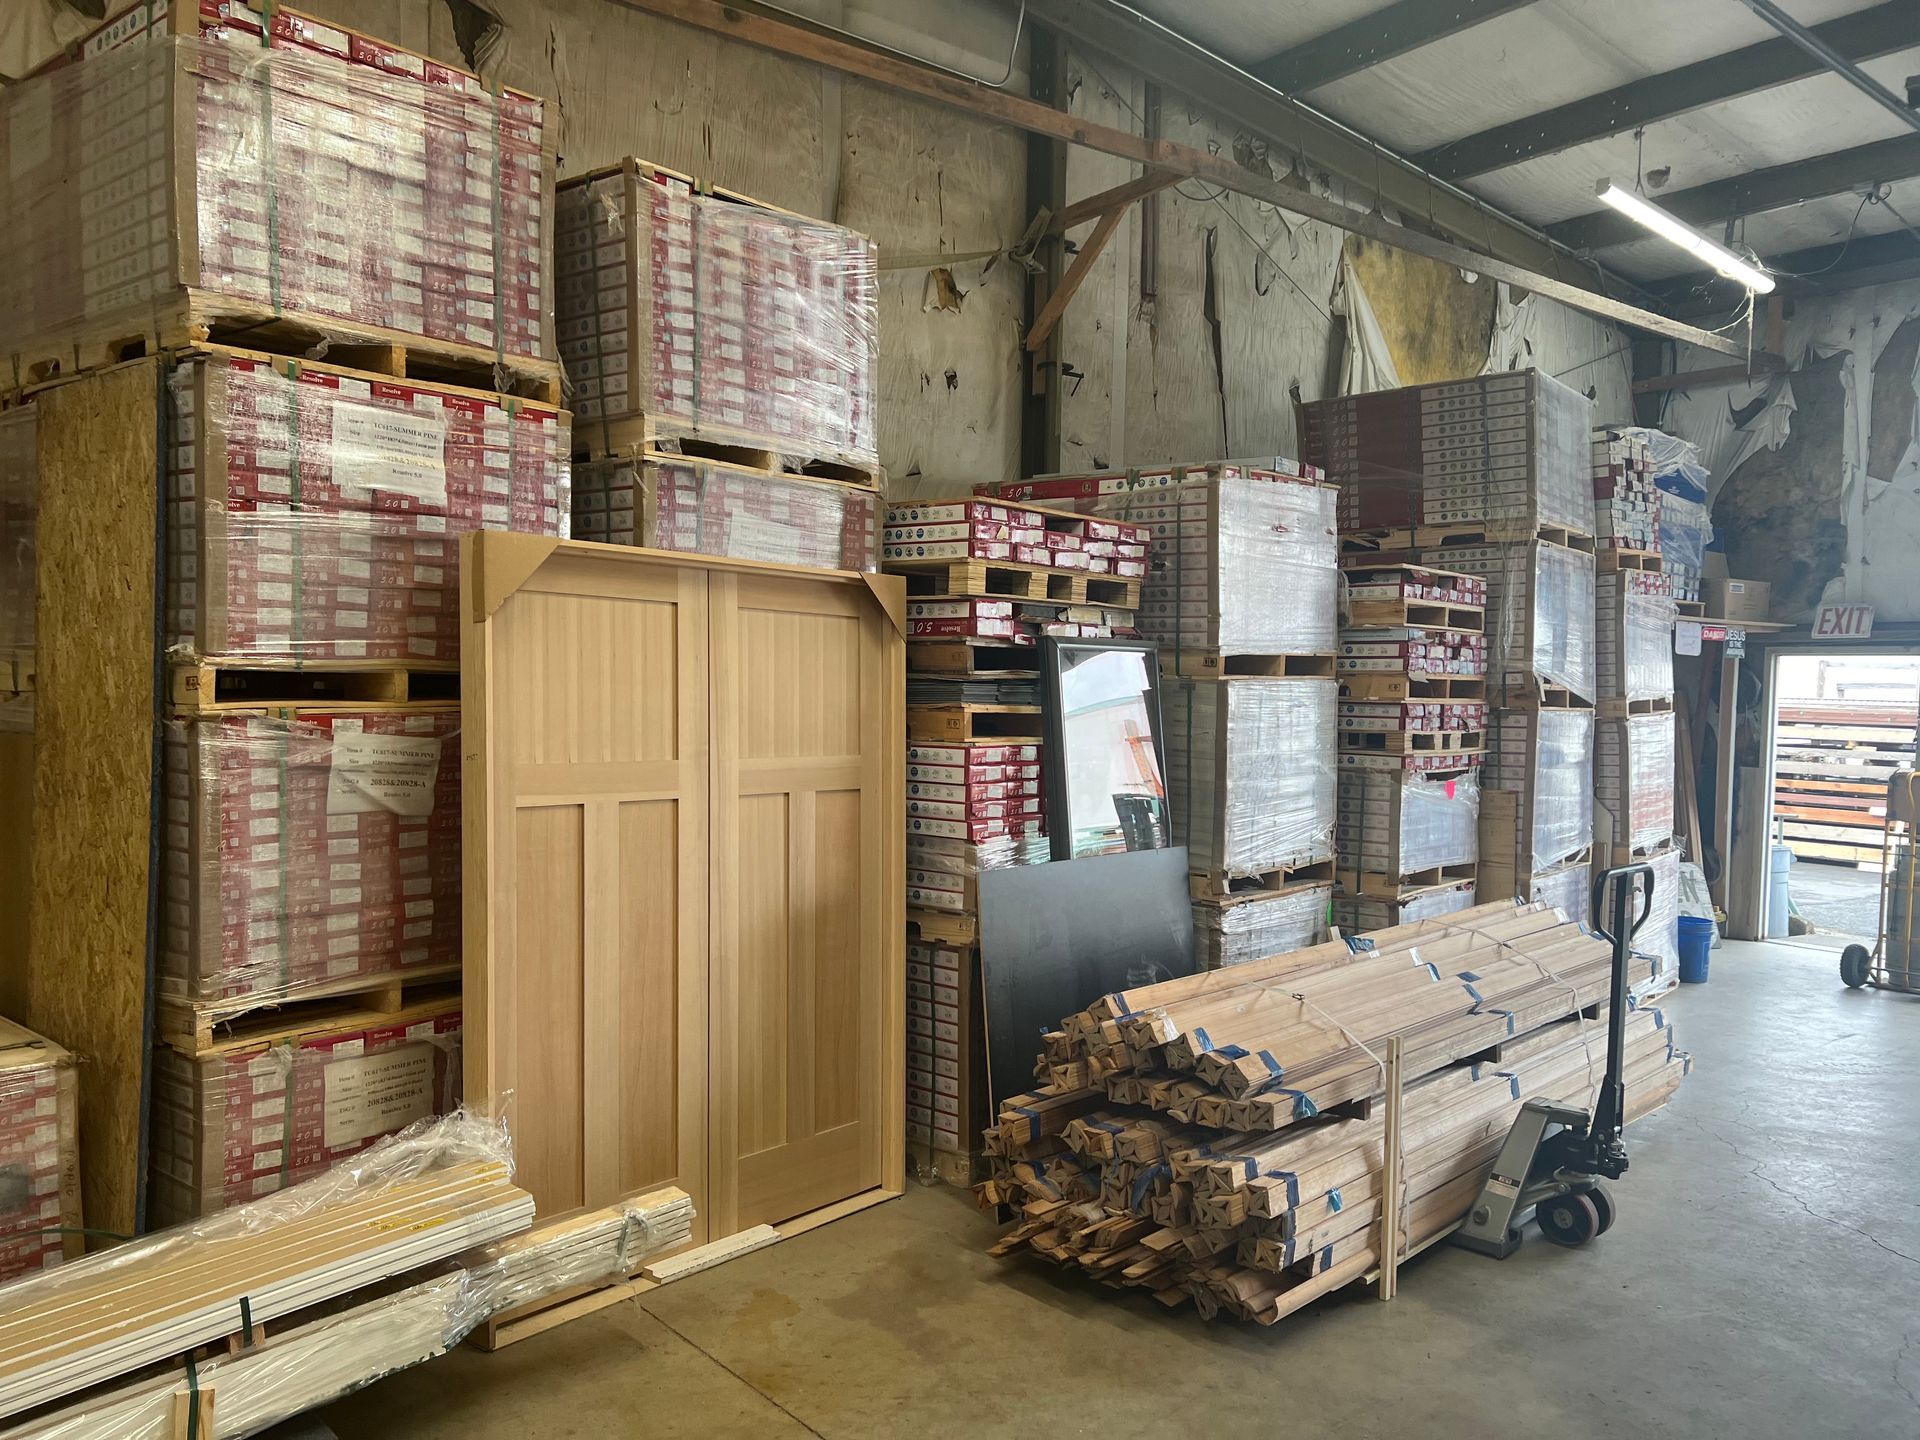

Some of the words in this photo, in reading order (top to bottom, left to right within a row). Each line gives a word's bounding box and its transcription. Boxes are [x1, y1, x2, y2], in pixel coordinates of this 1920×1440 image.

[302, 375, 324, 383] Resolve
[382, 387, 400, 395] Resolve
[452, 399, 470, 407] Resolve
[422, 432, 438, 440] PINE
[1008, 488, 1022, 498] 5.0
[1817, 606, 1869, 635] EXIT
[916, 622, 933, 632] 5.0
[1726, 630, 1746, 641] JESUS
[370, 780, 426, 788] 20828&20828-A
[367, 1088, 423, 1108] 20828&20828-A
